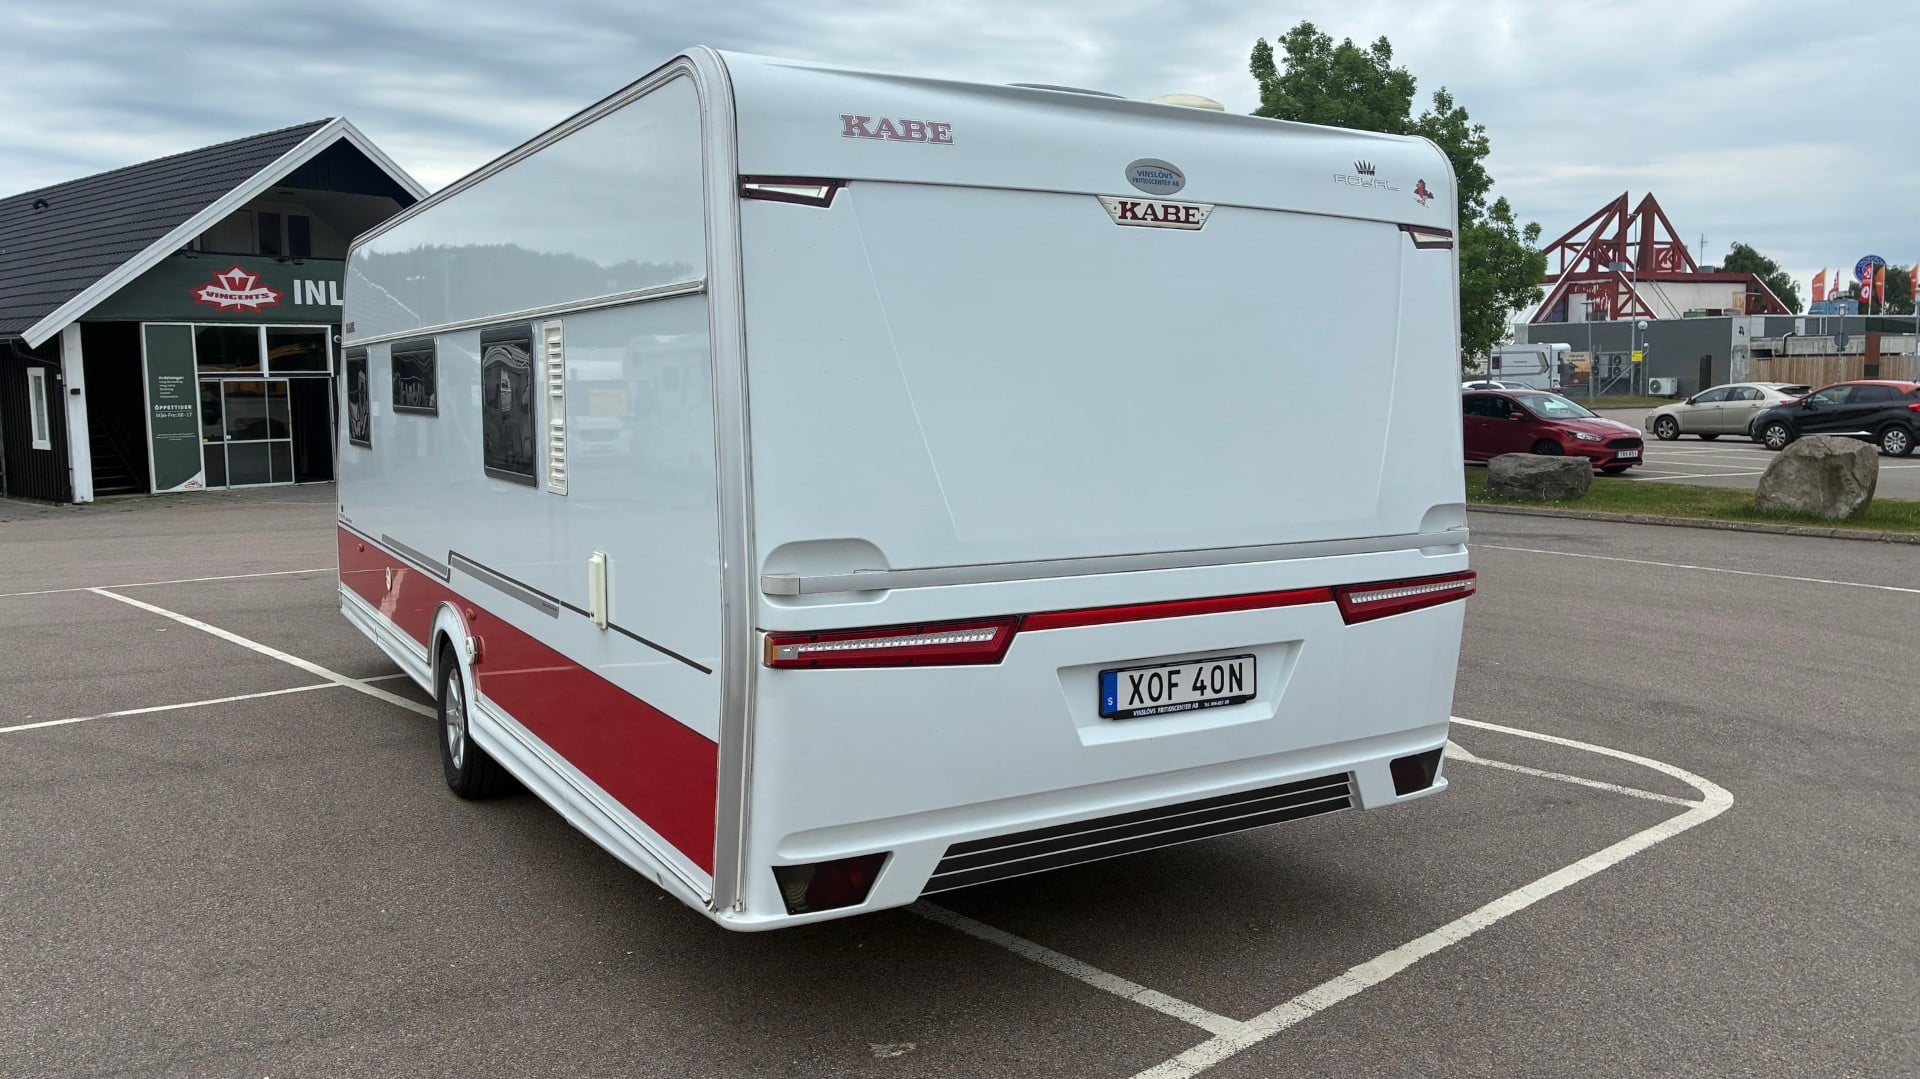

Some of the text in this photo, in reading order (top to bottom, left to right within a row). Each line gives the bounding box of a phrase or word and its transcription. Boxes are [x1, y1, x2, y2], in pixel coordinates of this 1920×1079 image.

[840, 114, 954, 145] KABE
[1136, 170, 1173, 179] VINSLÖVS
[1333, 174, 1400, 191] ROYAL
[1118, 201, 1200, 225] KABE
[205, 291, 270, 300] VINCENTS
[1128, 669, 1181, 706] XOF
[1107, 697, 1114, 706] S
[1133, 707, 1156, 717] VINSLÖVS
